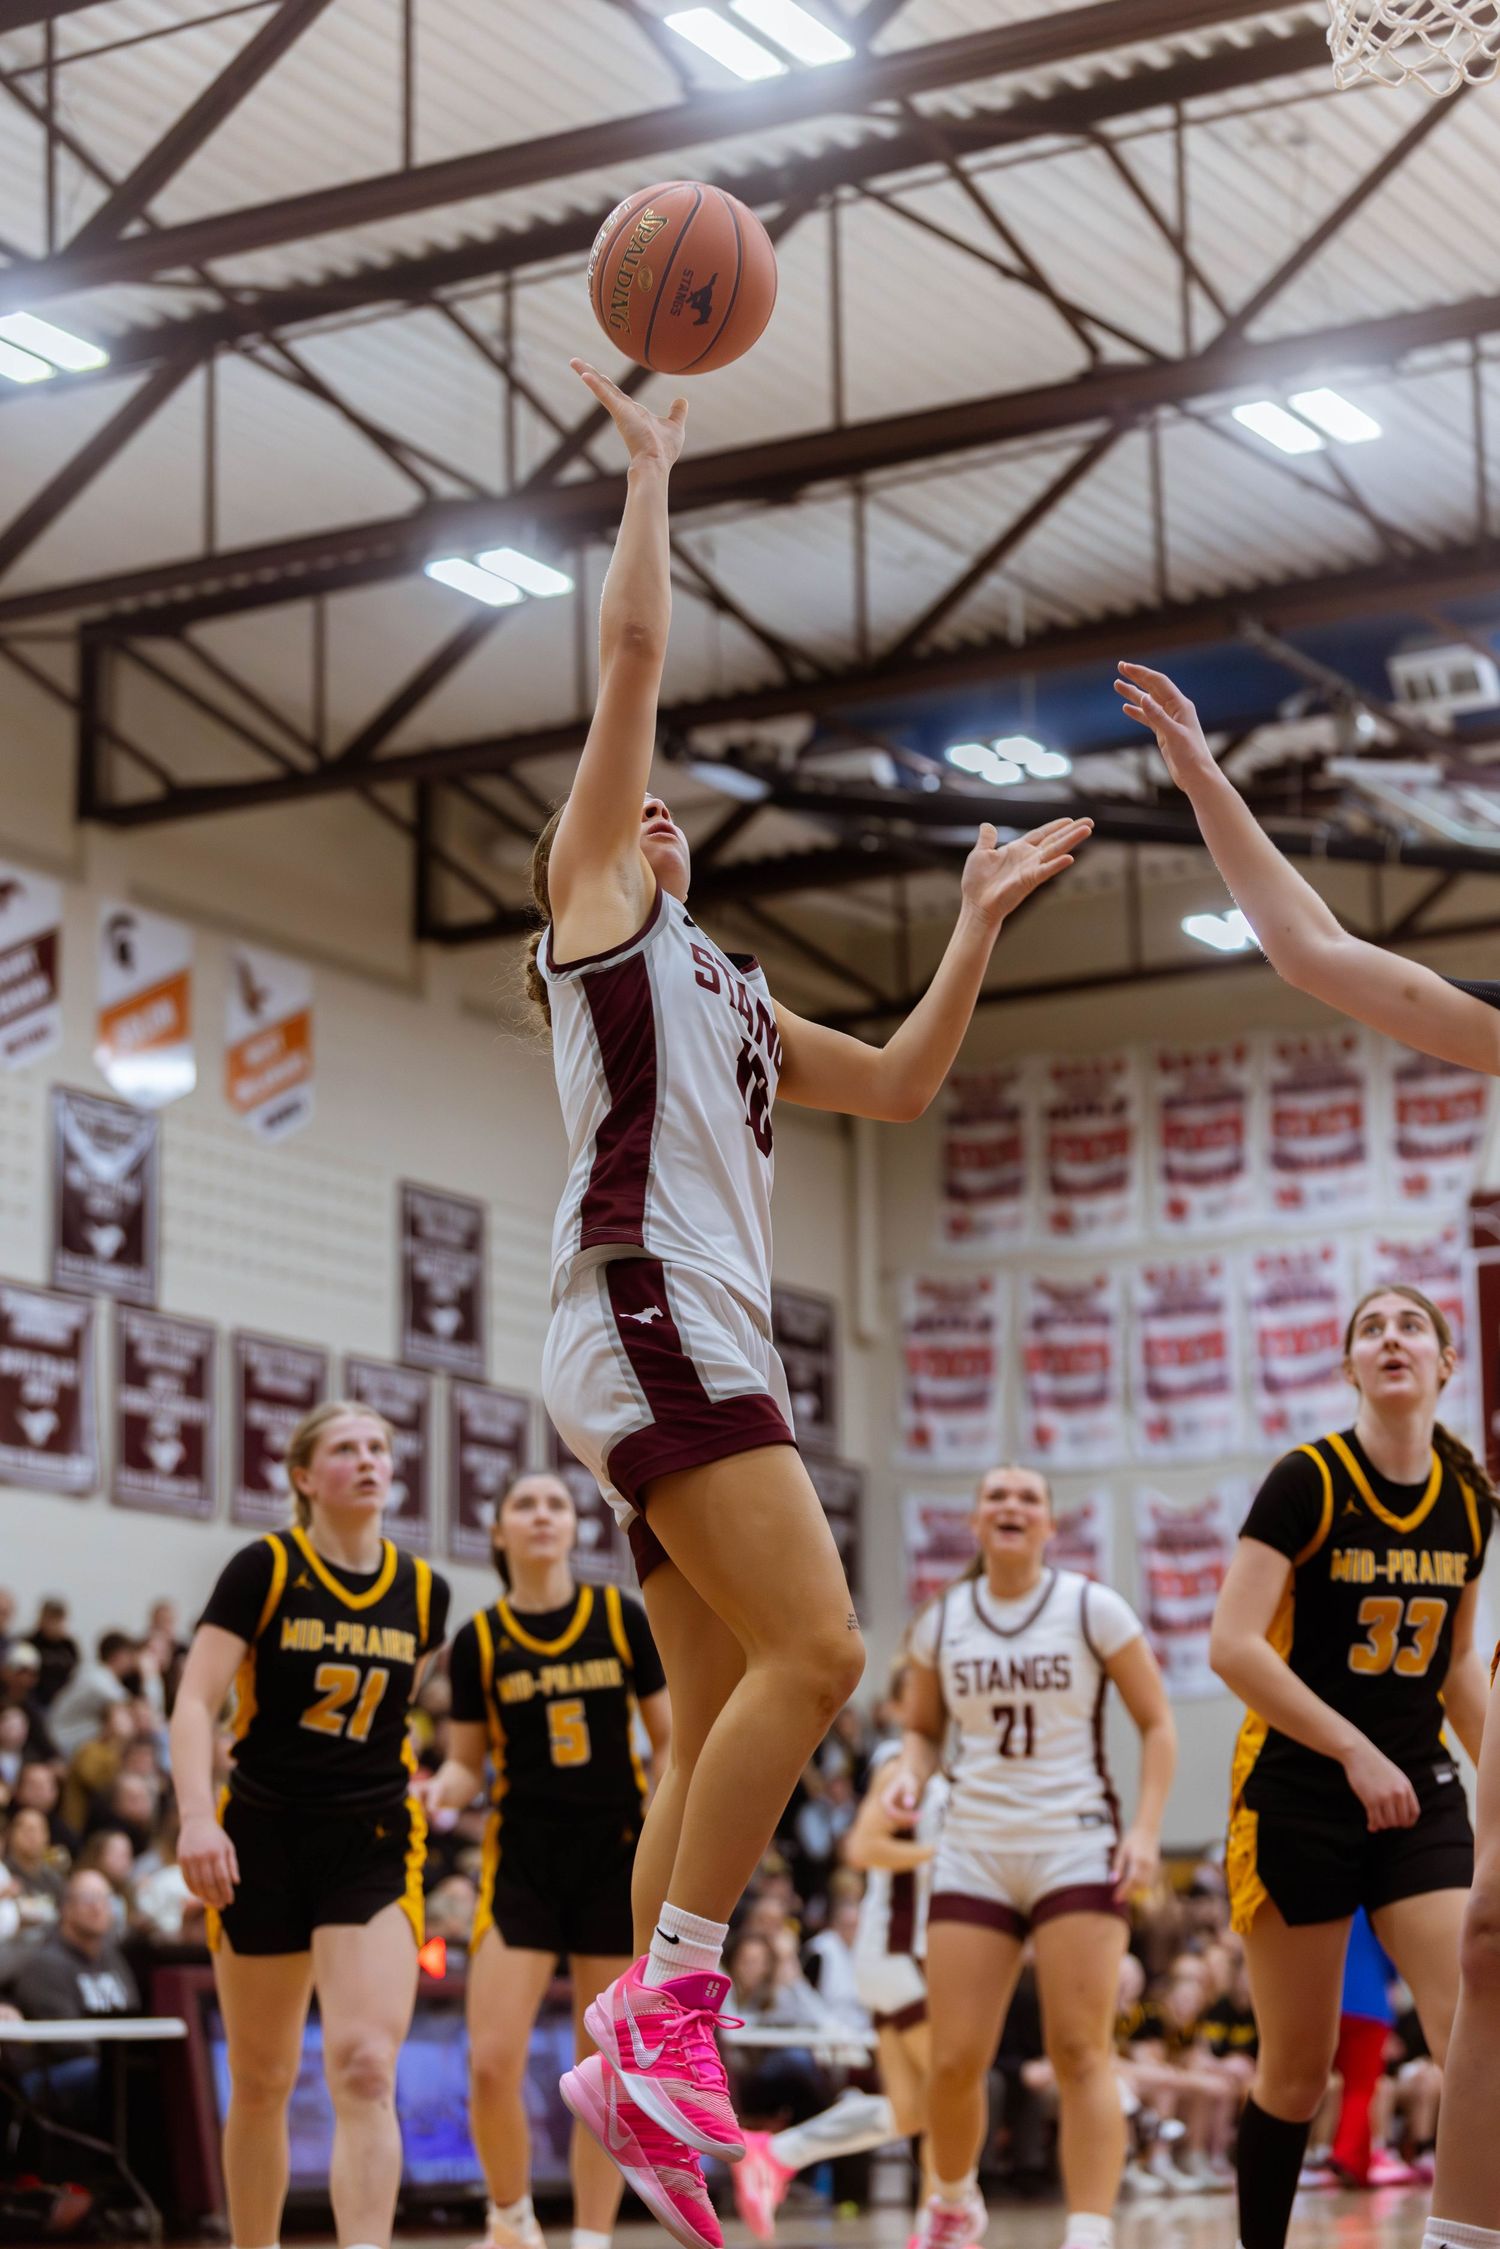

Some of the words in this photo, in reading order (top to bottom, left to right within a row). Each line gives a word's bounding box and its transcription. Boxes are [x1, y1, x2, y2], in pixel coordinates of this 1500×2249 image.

[608, 207, 669, 336] SPALDING
[669, 266, 695, 318] STANGS
[1347, 1596, 1448, 1678] 33
[298, 1662, 391, 1743] 21
[952, 1653, 1073, 1698] STANGS
[545, 1696, 593, 1769] 5
[992, 1703, 1037, 1760] 21
